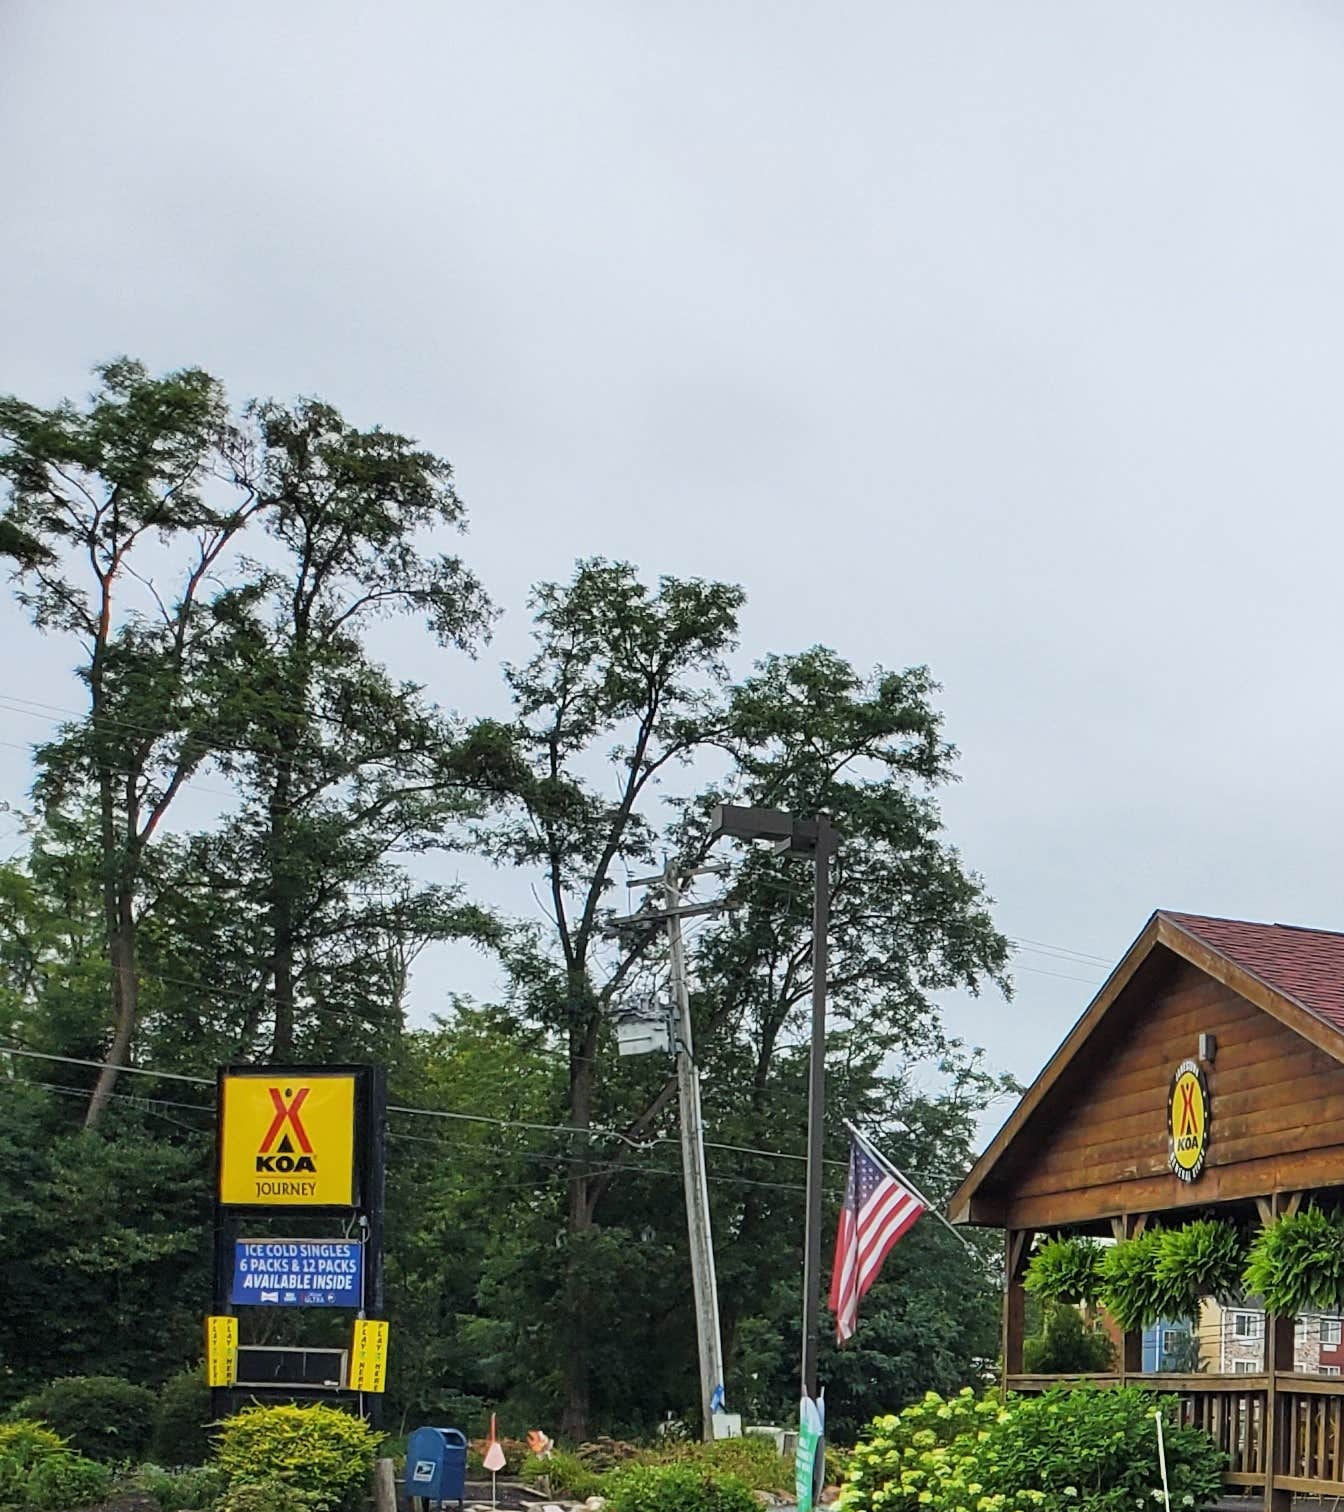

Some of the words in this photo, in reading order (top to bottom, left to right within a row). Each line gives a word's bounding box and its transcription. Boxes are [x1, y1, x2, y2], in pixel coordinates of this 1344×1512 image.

[1177, 1136, 1199, 1151] KOA
[256, 1155, 317, 1173] KOA
[255, 1182, 317, 1198] JOURNEY
[245, 1244, 265, 1257] ICE
[266, 1244, 298, 1257] COLD
[300, 1244, 351, 1257] SINGLES
[240, 1259, 248, 1271] 6
[250, 1259, 289, 1272] PACKS
[291, 1259, 300, 1272] &
[302, 1259, 316, 1273] 12
[318, 1259, 357, 1273] PACKS
[243, 1273, 311, 1289] AVAILABLE
[312, 1274, 353, 1290] INSIDE
